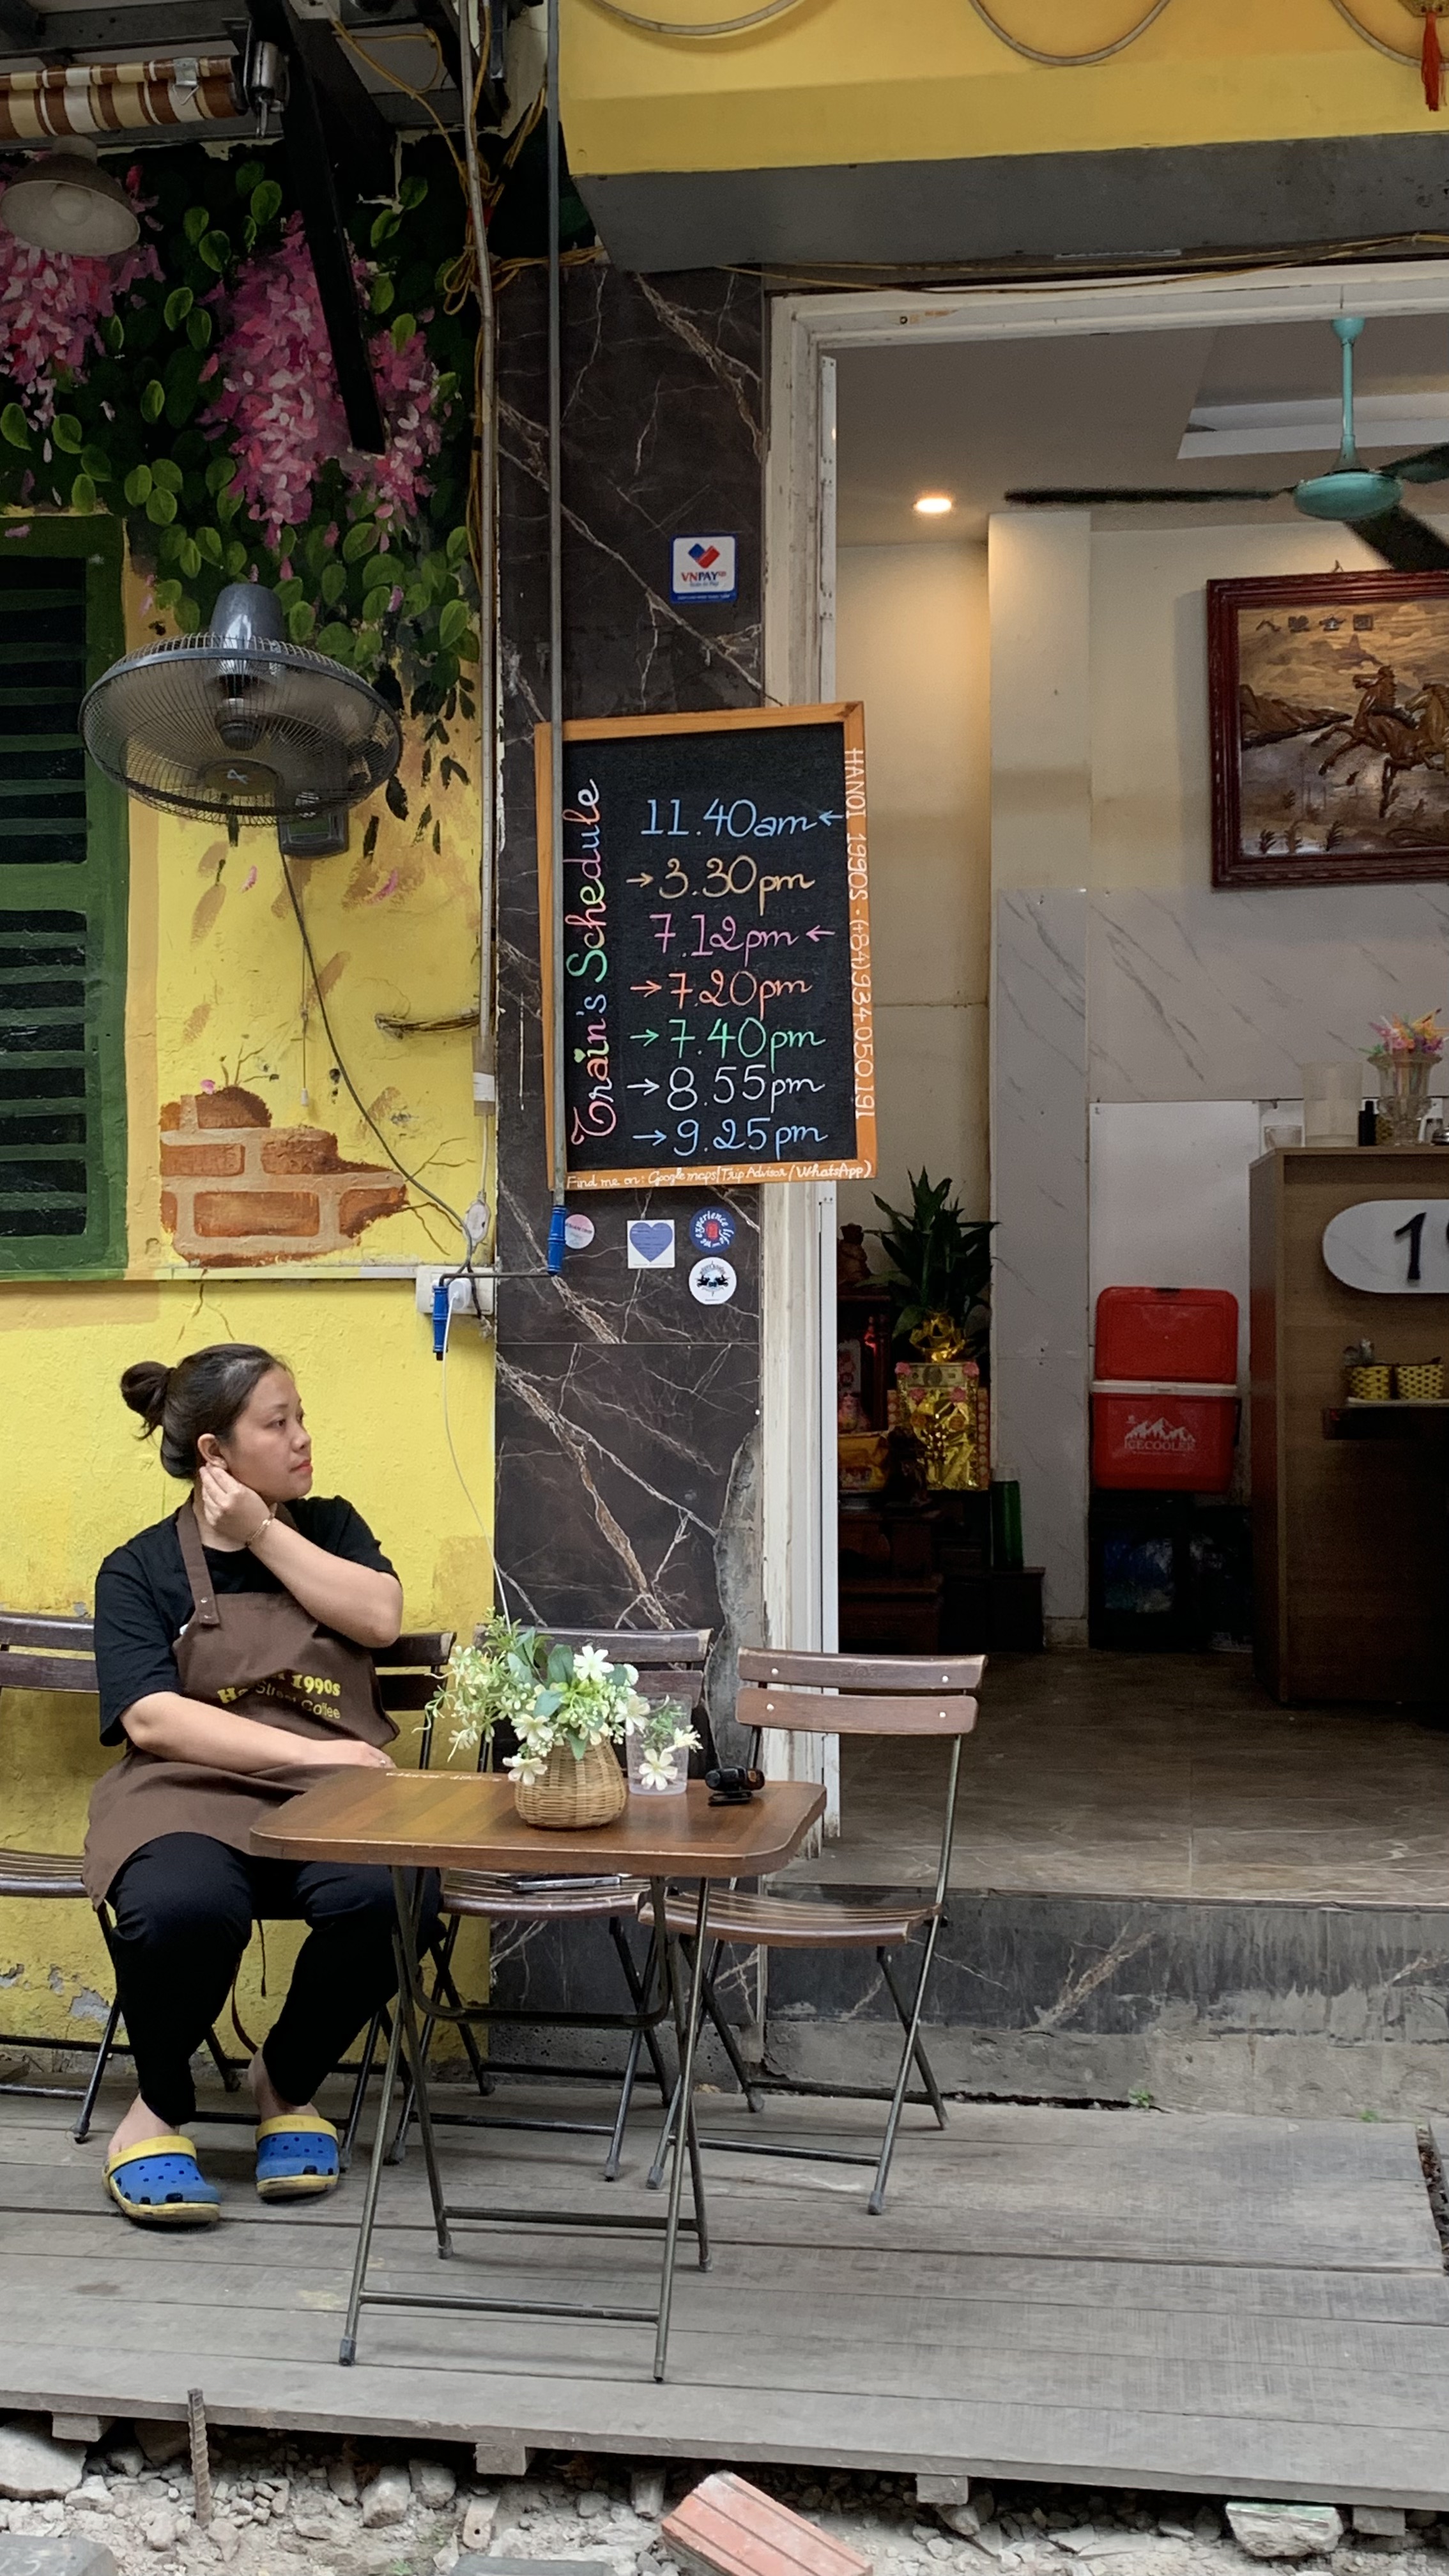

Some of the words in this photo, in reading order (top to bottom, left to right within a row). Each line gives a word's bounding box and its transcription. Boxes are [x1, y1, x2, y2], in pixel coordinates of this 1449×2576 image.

[845, 747, 866, 819] HANOI
[641, 799, 817, 837] 11.40am
[562, 778, 608, 983] Schedule
[659, 855, 815, 916] 3.30pm
[649, 913, 799, 967] 7.12pm
[669, 970, 813, 1021] 7.20pm
[849, 919, 875, 1119] (+84)934.050.191
[571, 994, 617, 1145] Train's
[669, 1017, 825, 1073] 7.40pm
[667, 1064, 825, 1113] 8.55pm
[673, 1117, 828, 1160] 9.25pm
[567, 1174, 597, 1189] Find
[601, 1178, 620, 1187] me
[648, 1167, 686, 1186] Google
[746, 1165, 787, 1178] Advisor
[292, 1674, 341, 1697] 1990s
